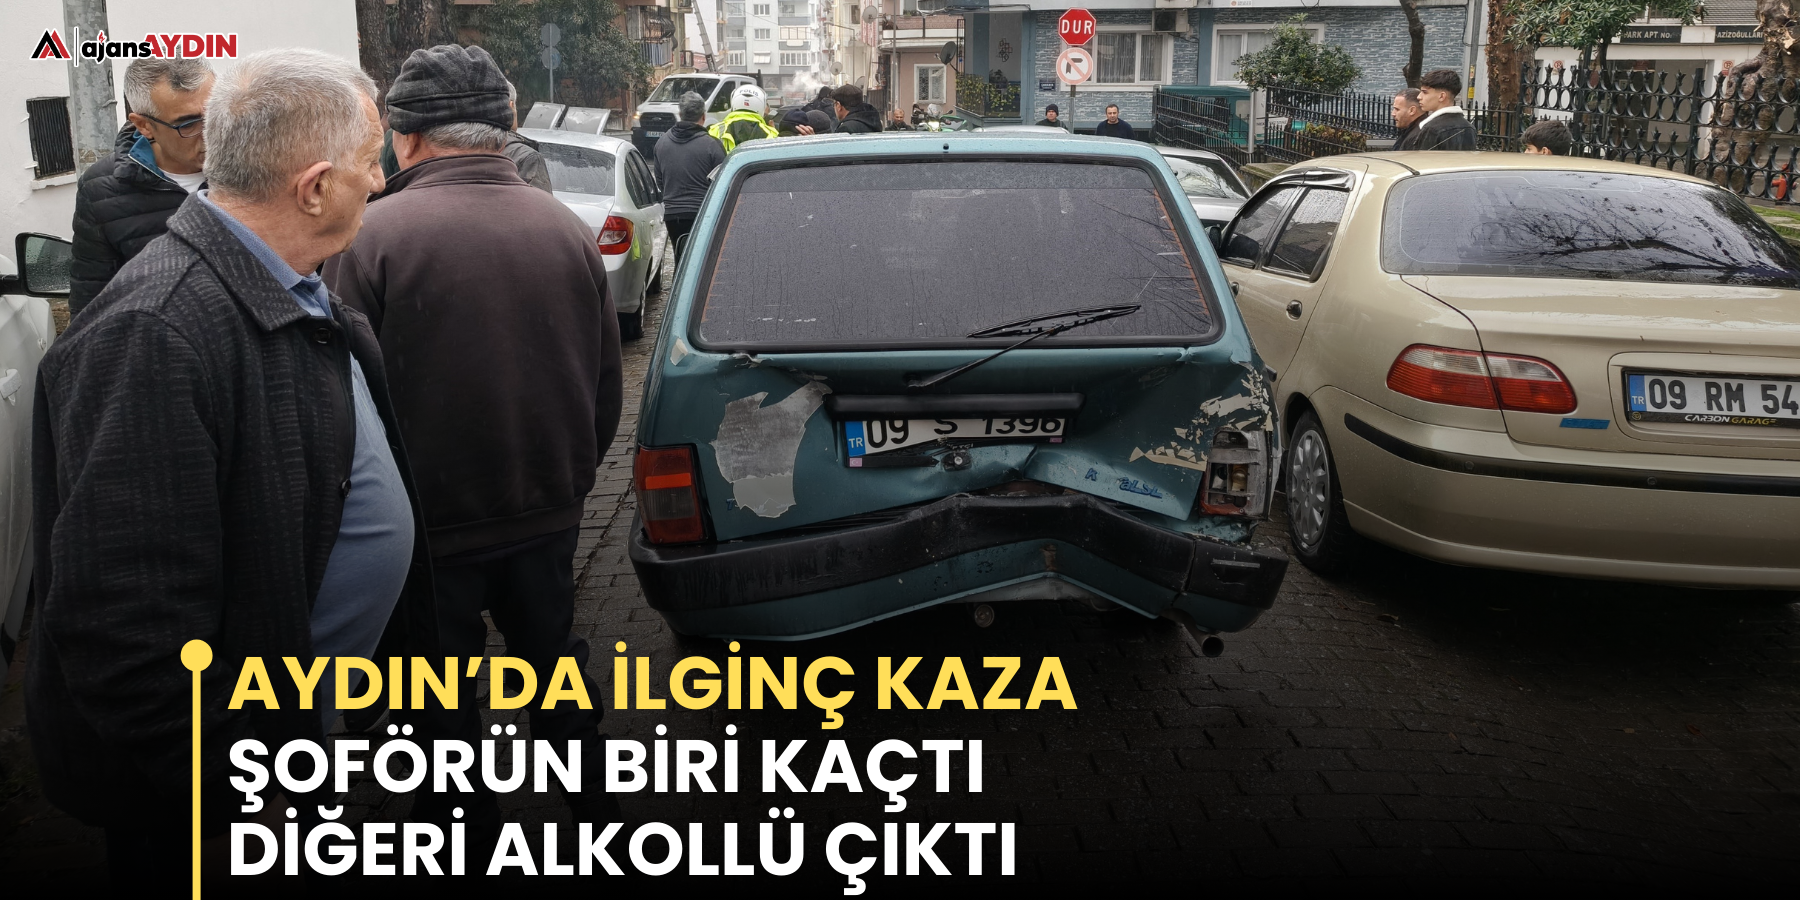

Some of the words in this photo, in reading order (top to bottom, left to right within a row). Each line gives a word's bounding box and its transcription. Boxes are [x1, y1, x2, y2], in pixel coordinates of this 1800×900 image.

[1061, 19, 1093, 35] DUR
[1632, 396, 1645, 405] TR
[1648, 378, 1688, 410] 09
[1704, 381, 1747, 413] RM
[866, 419, 909, 449] 09
[848, 437, 864, 449] TR
